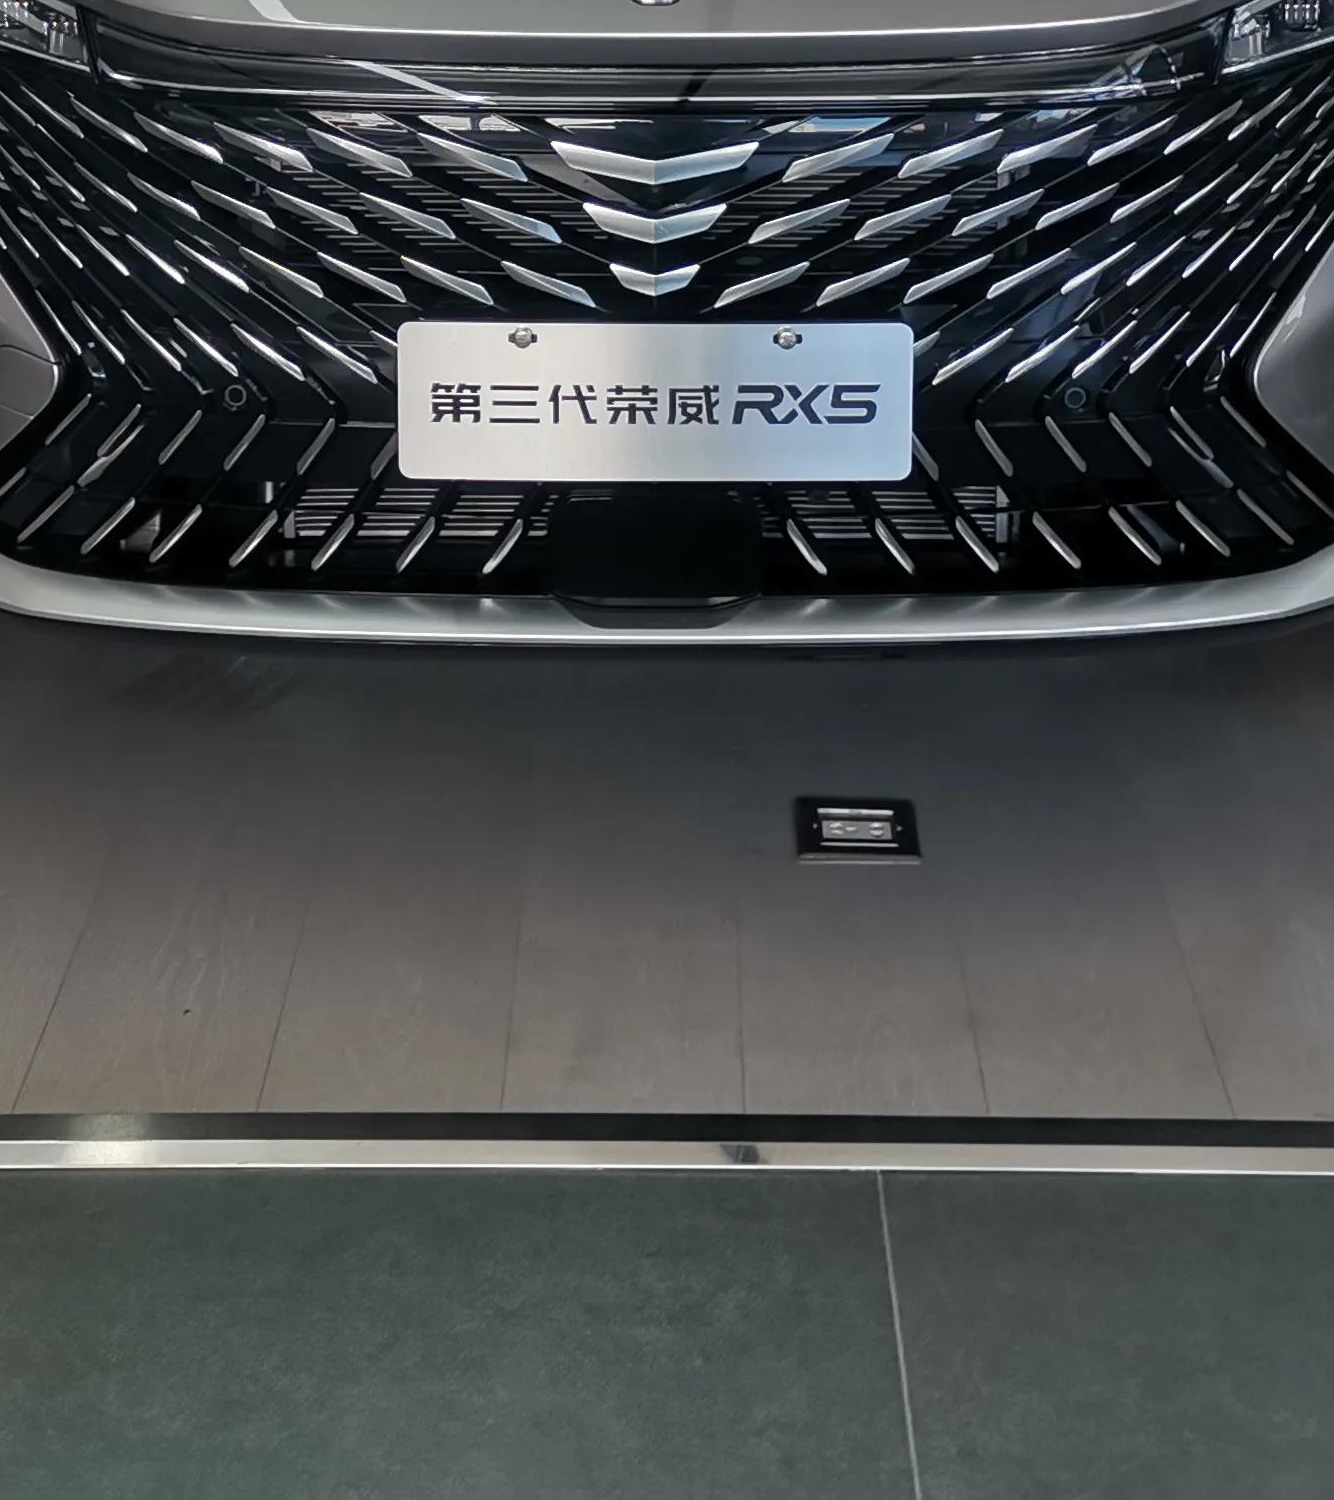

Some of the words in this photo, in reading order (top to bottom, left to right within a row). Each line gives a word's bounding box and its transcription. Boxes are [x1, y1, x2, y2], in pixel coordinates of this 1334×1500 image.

[429, 382, 881, 425] 第三代荣威RX5
